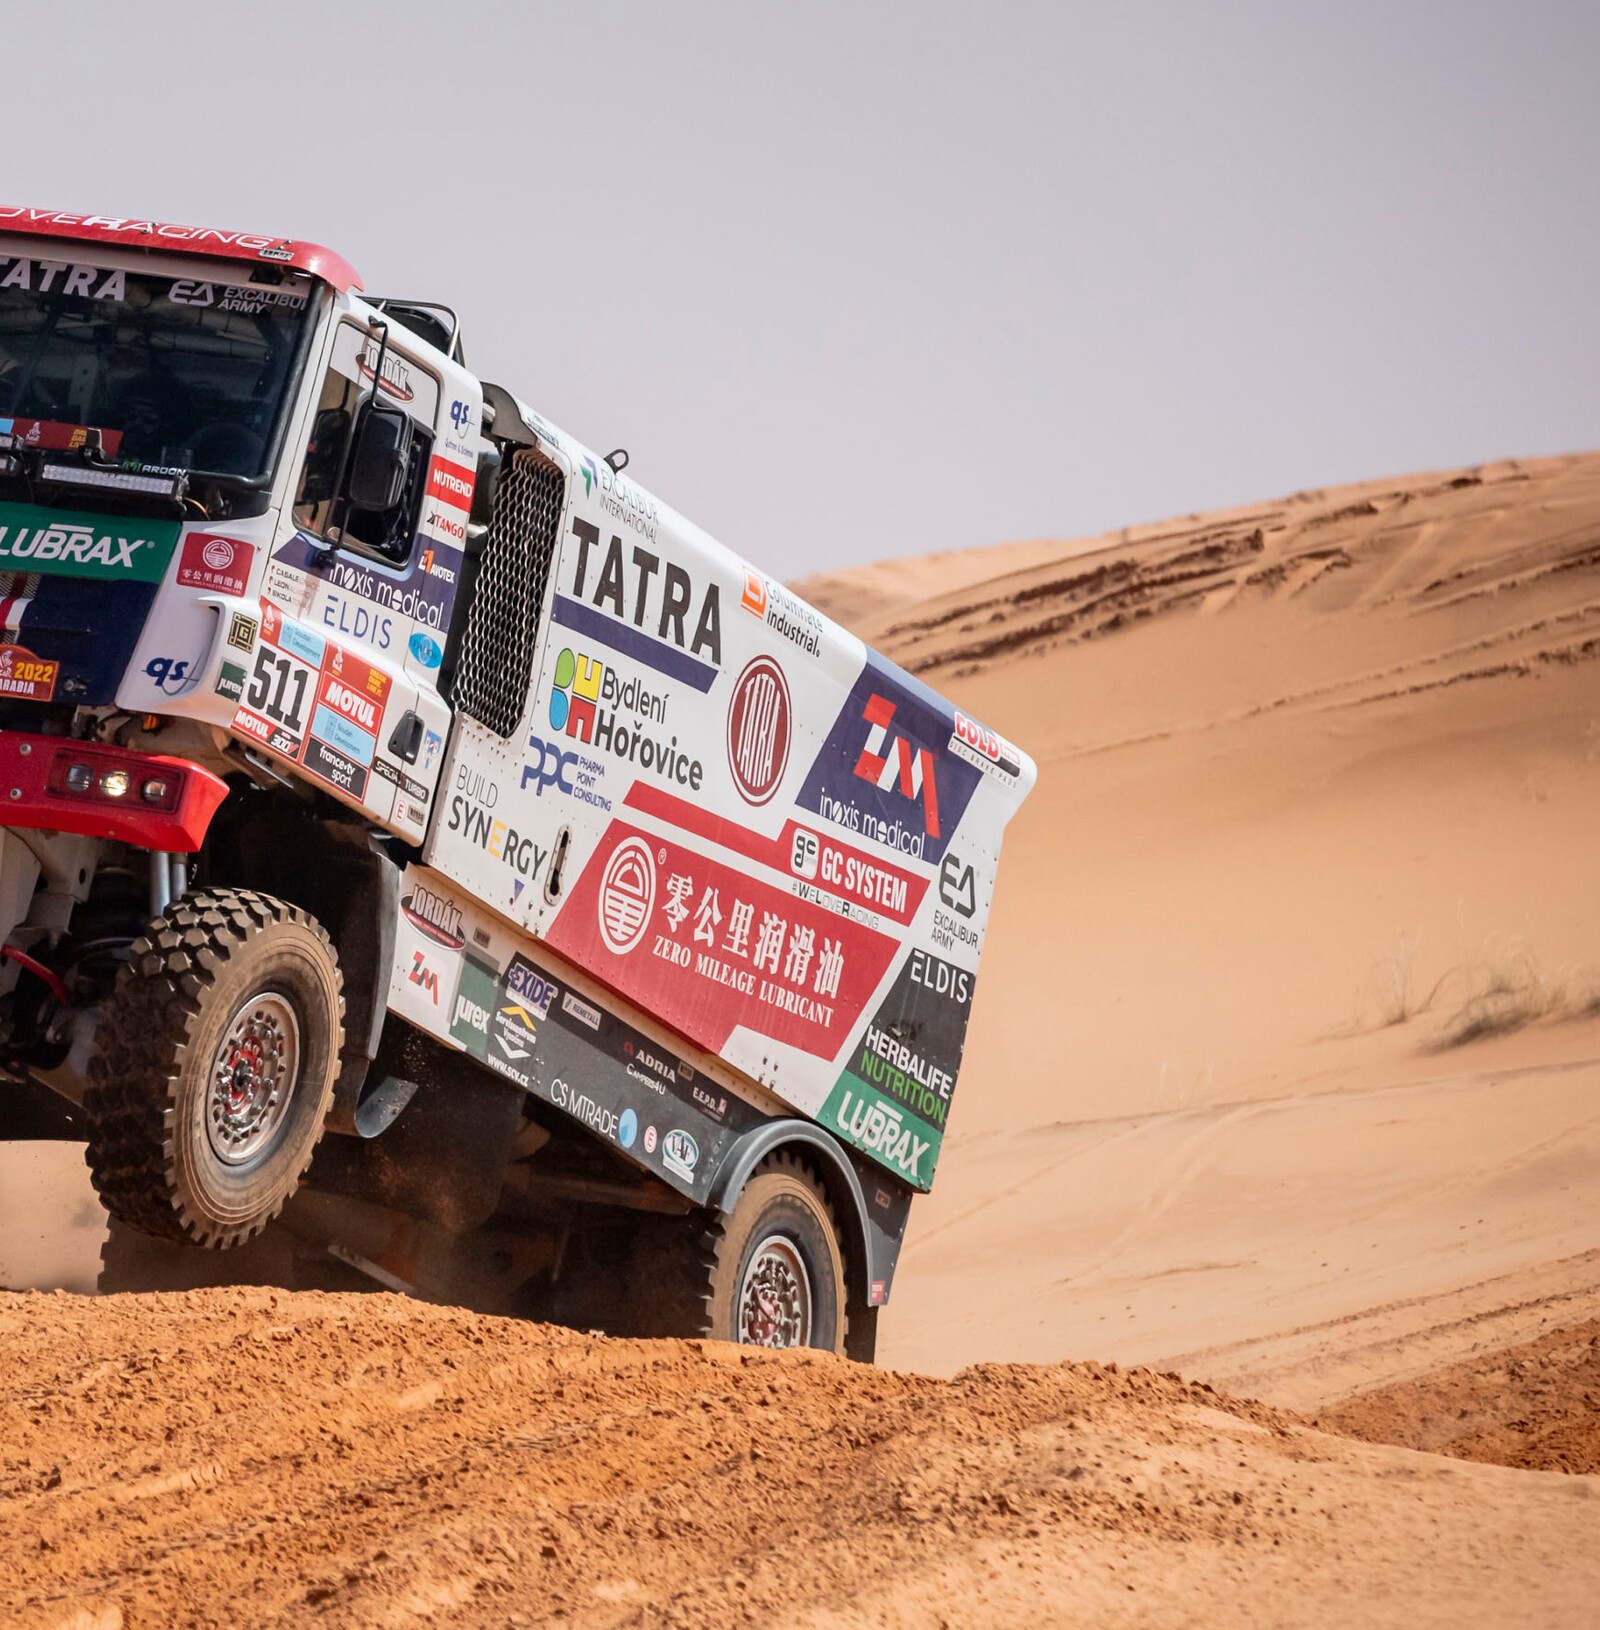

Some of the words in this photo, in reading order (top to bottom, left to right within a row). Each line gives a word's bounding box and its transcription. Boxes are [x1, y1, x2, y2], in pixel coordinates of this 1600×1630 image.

[217, 299, 268, 315] ARMY
[142, 464, 187, 477] ARDON
[433, 468, 473, 498] NUTREND
[435, 514, 465, 539] TANGO
[601, 493, 657, 545] INTERNATIONAL
[329, 562, 376, 599] inoxis
[375, 581, 444, 629] medical
[572, 516, 721, 666] TATRA
[323, 594, 393, 649] ELDIS
[14, 662, 53, 683] 2022
[248, 645, 308, 733] 511
[602, 666, 670, 724] Bydlení
[234, 709, 270, 739] MOTUL
[324, 680, 375, 729] MOTUL
[270, 734, 300, 755] 300V
[594, 708, 703, 791] Hořovice
[736, 672, 781, 788] TATRA
[955, 712, 1000, 760] GOLD
[331, 768, 353, 789] sport
[404, 778, 426, 800] TURBO
[456, 764, 499, 809] BUILD
[577, 771, 596, 788] POINT
[578, 756, 606, 778] PHARMA
[573, 788, 613, 813] CONSULTING
[819, 787, 860, 831] inoxis
[862, 813, 927, 861] medical
[448, 795, 548, 881] SYNERGY
[821, 846, 844, 886] GC
[844, 856, 909, 914] SYSTEM
[409, 884, 463, 938] JORDÁK
[933, 909, 979, 949] EXCALIBUR
[662, 872, 845, 1000] 零公里润滑油
[930, 927, 956, 952] ARMY
[509, 964, 555, 1011] EXIDE
[652, 934, 692, 968] ZERO
[694, 953, 757, 996] MILEAGE
[758, 979, 835, 1029] LUBRICANT
[451, 995, 491, 1035] jurex
[635, 1050, 676, 1084] ADRIA
[865, 1024, 953, 1100] HERBALIFE
[550, 1078, 569, 1108] CS
[568, 1089, 619, 1140] MTRADE
[860, 1050, 948, 1125] NUTRITION
[837, 1090, 931, 1178] LUBRAX
